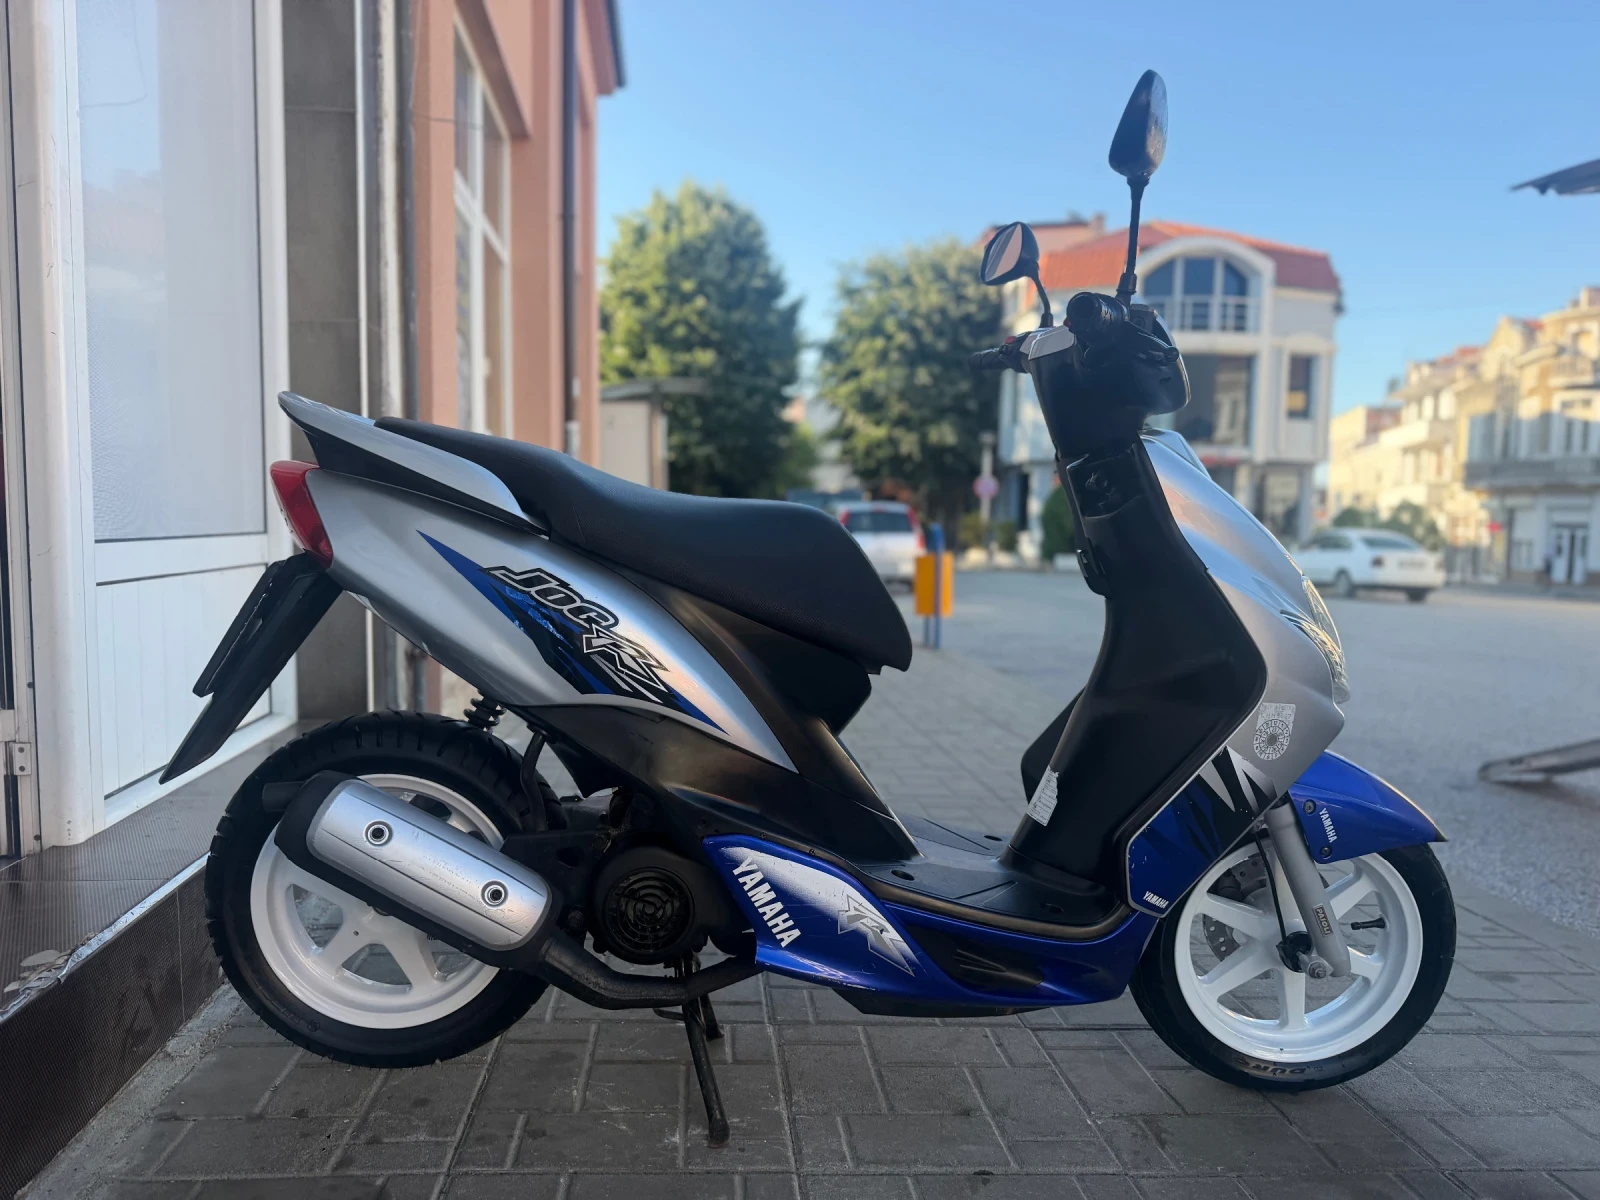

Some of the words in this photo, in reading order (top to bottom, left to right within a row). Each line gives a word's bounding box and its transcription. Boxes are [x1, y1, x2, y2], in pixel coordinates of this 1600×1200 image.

[481, 566, 619, 630] JOG
[1319, 807, 1338, 843] YAMAHA
[732, 857, 801, 948] YAMAHA
[1143, 890, 1169, 909] YAMAHA
[1315, 906, 1332, 935] PAIOLI
